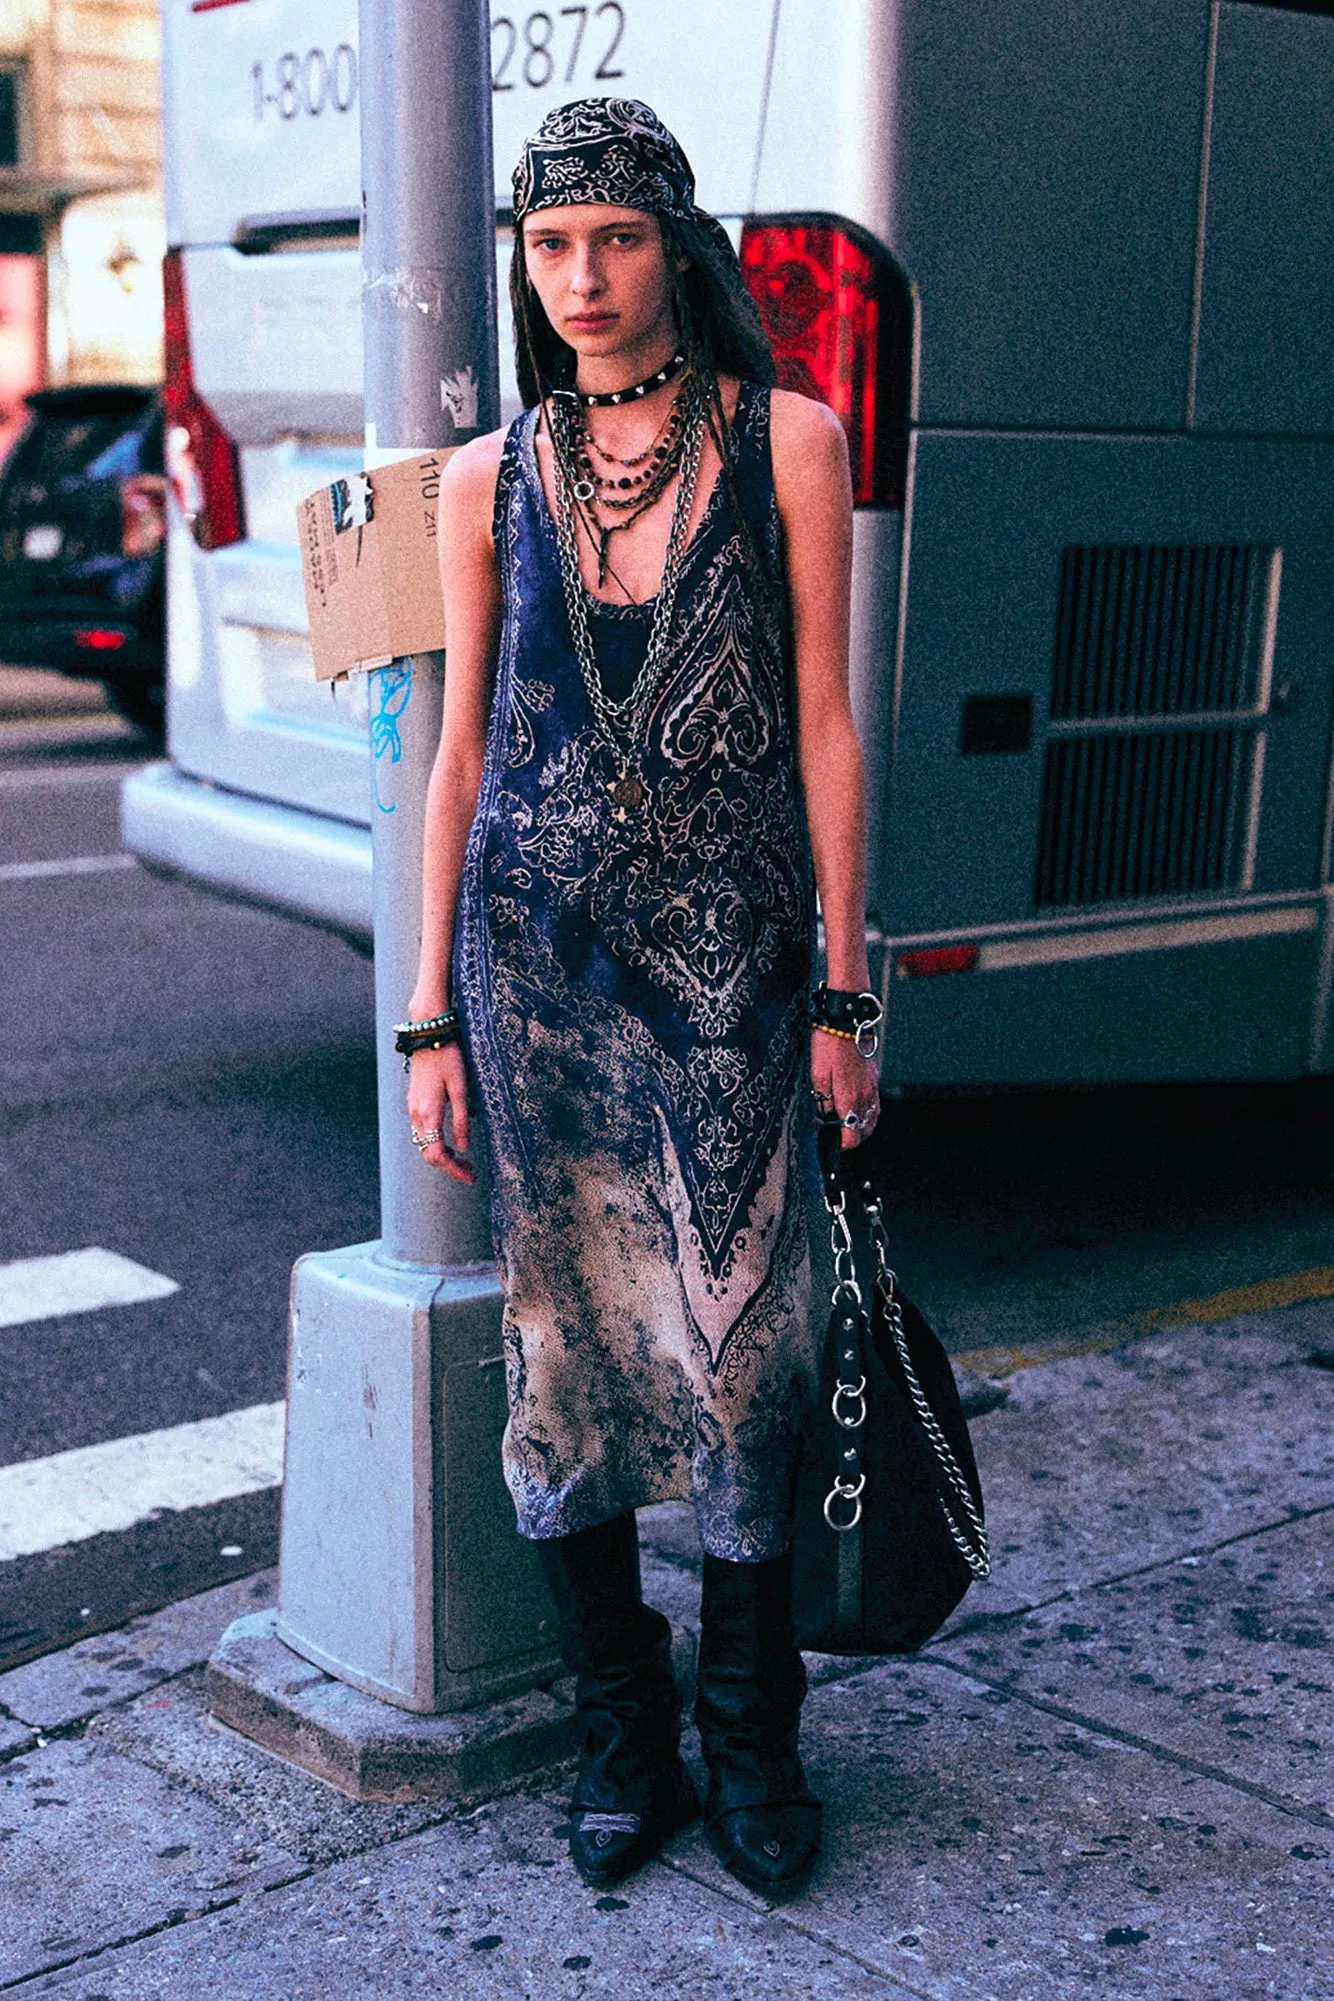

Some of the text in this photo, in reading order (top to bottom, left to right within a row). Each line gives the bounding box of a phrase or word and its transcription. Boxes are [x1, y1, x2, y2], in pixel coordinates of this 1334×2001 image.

[250, 1, 624, 120] 1-800 2872
[419, 457, 441, 499] 110
